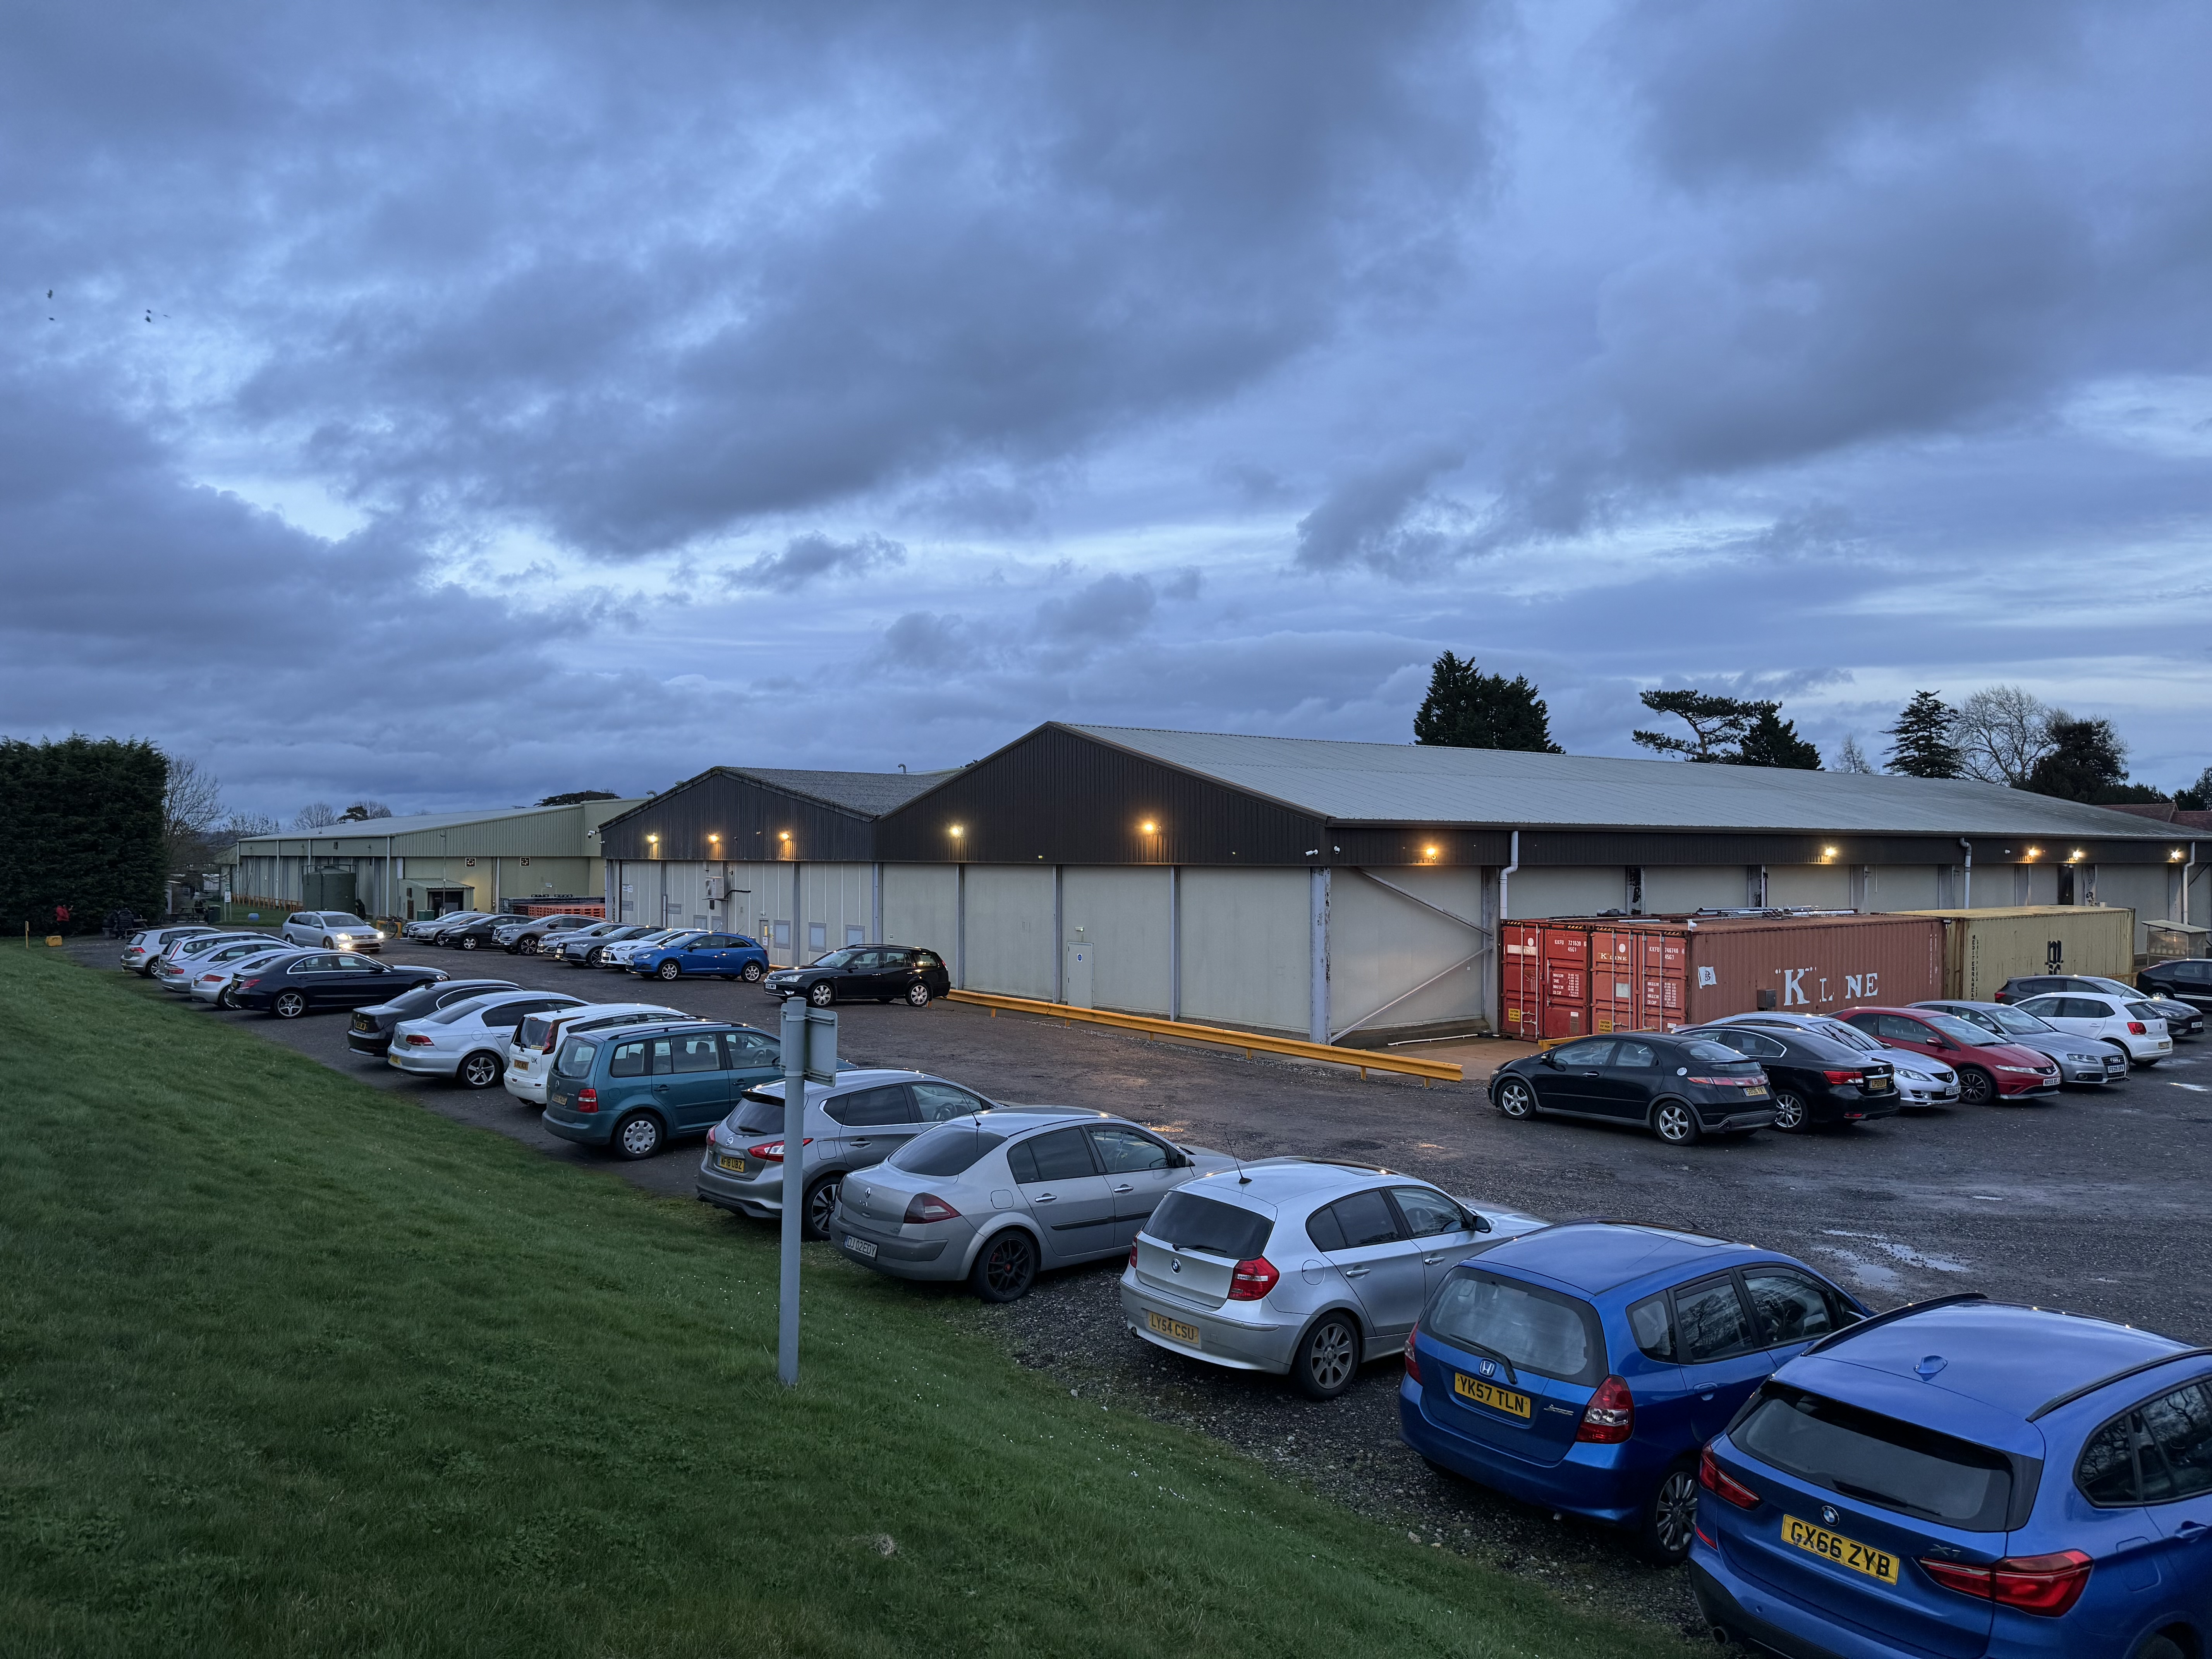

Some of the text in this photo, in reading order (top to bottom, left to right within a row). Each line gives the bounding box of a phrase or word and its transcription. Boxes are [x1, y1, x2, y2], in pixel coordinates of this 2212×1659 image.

[732, 1159, 742, 1170] UBZ
[847, 1237, 855, 1248] DJ
[1152, 1314, 1194, 1340] LY54 CSU
[1460, 1376, 1523, 1413] YK57 TLN
[1791, 1522, 1890, 1577] GX66 ZYB
